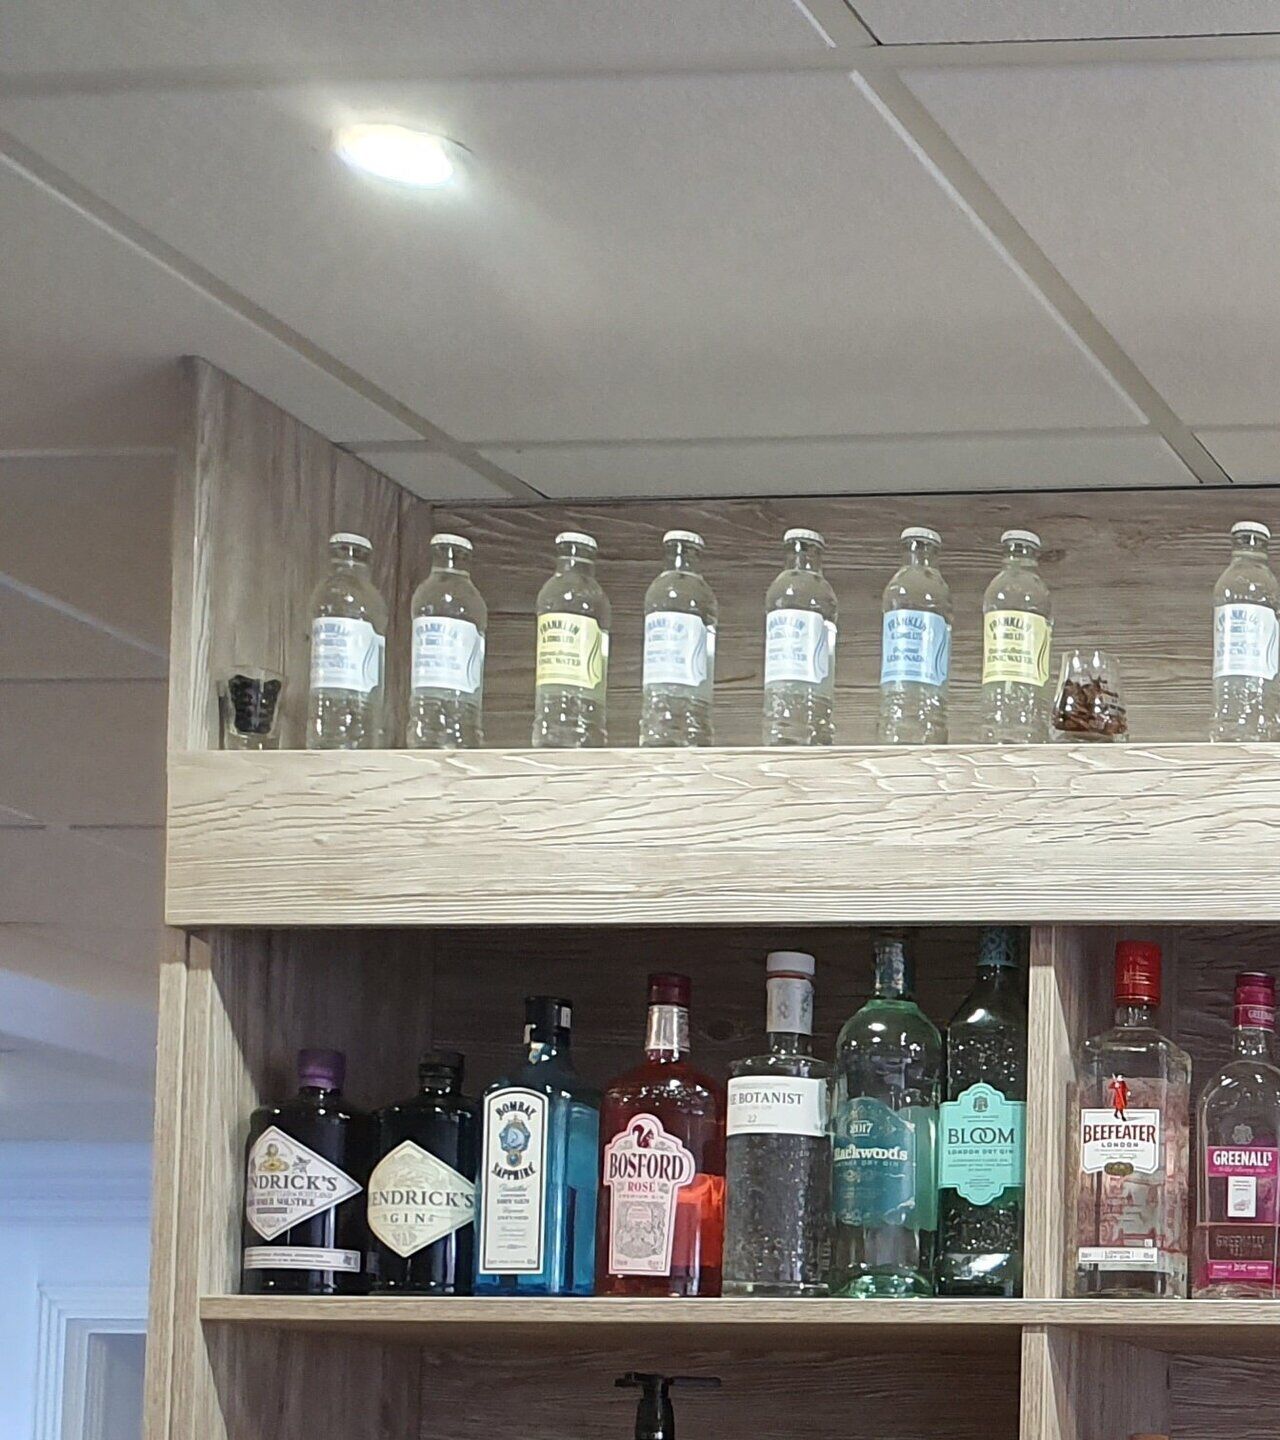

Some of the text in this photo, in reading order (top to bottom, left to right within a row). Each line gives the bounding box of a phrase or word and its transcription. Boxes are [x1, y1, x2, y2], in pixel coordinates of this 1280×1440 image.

[739, 1092, 805, 1106] BOTANIST
[746, 1115, 758, 1123] 22
[850, 1120, 873, 1134] 2017
[1083, 1124, 1157, 1145] BEEFEATER
[948, 1127, 1015, 1144] BLOOM
[1212, 1150, 1273, 1167] GREENALL'S
[609, 1152, 684, 1181] BOSFORD
[391, 1212, 426, 1224] GIN
